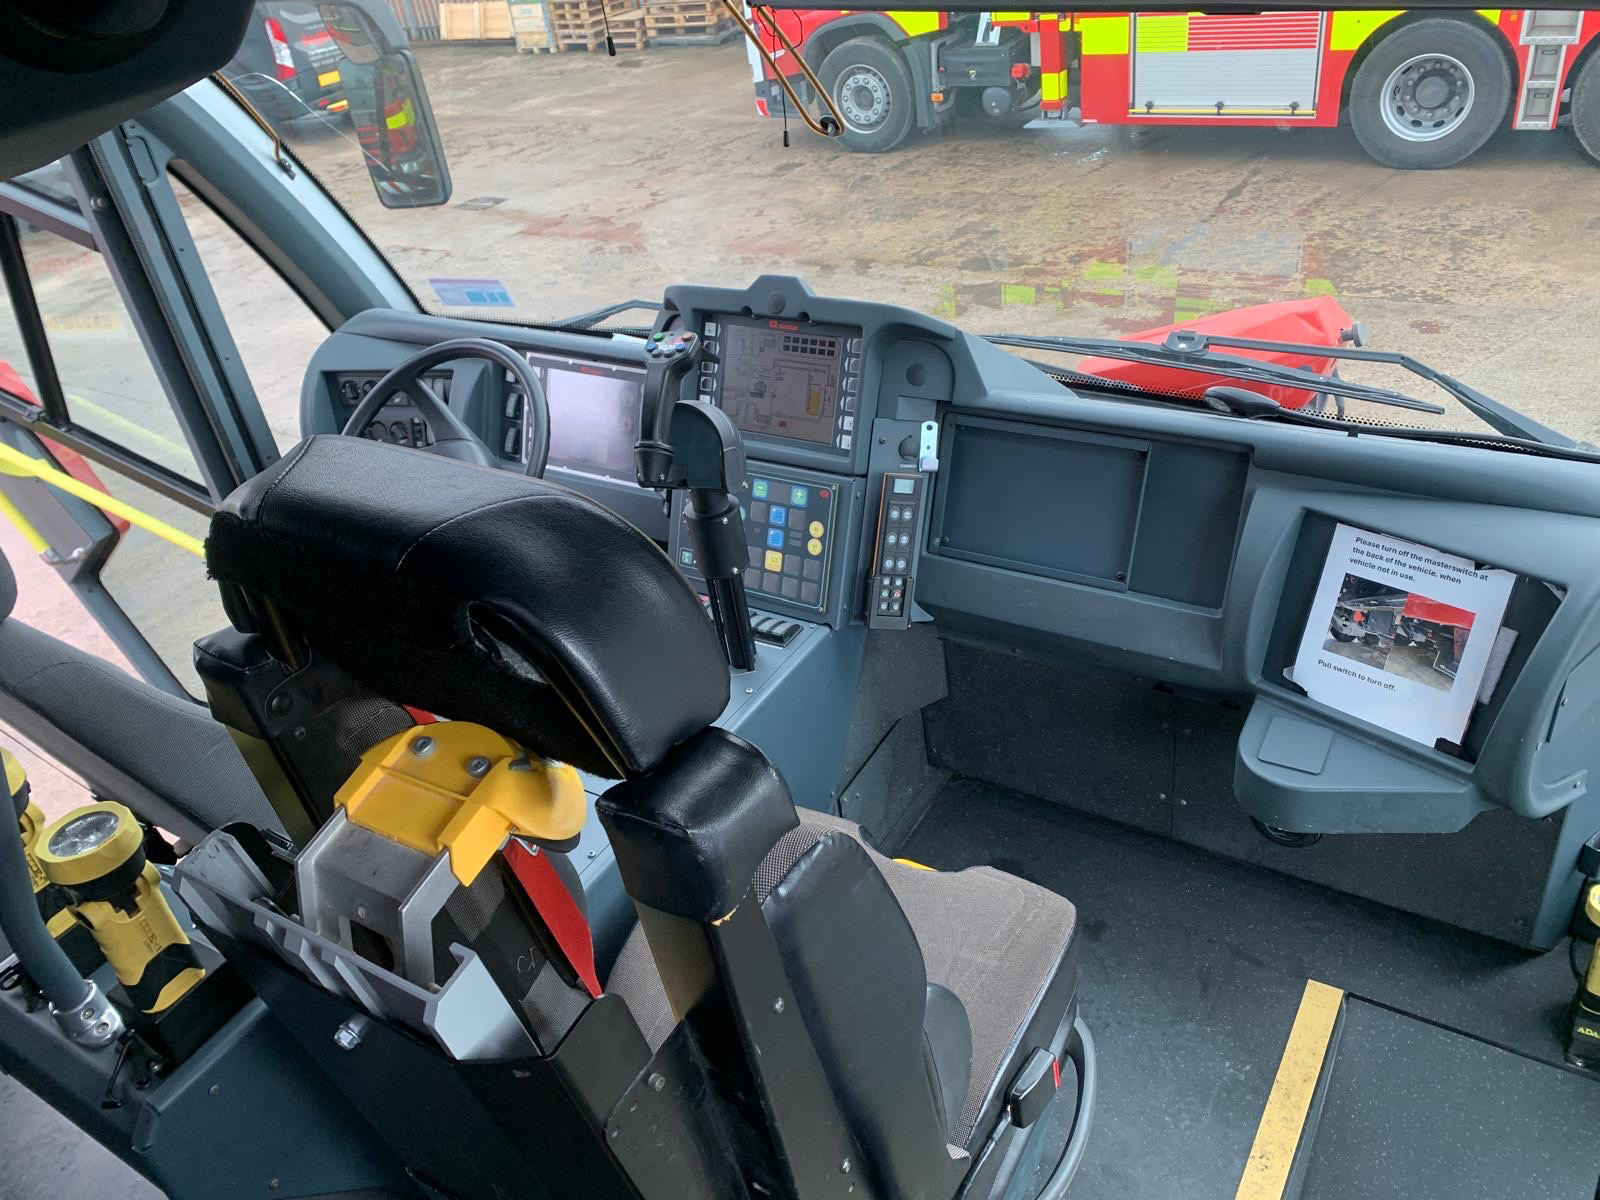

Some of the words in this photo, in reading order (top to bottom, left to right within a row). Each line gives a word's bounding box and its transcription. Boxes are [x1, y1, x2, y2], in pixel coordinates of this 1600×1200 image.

[1349, 557, 1376, 570] vehicle
[1377, 566, 1390, 574] not
[1400, 573, 1415, 581] use.
[1352, 547, 1365, 555] the
[1365, 550, 1384, 561] back
[1394, 559, 1407, 568] the
[1439, 573, 1462, 584] when
[1355, 536, 1380, 549] Please
[1381, 545, 1397, 554] turn
[1410, 553, 1423, 561] the
[1424, 557, 1478, 578] masterswitch
[1317, 659, 1332, 669] Pull
[1333, 665, 1357, 678] switch
[1367, 677, 1382, 687] turn
[1383, 683, 1397, 692] off.
